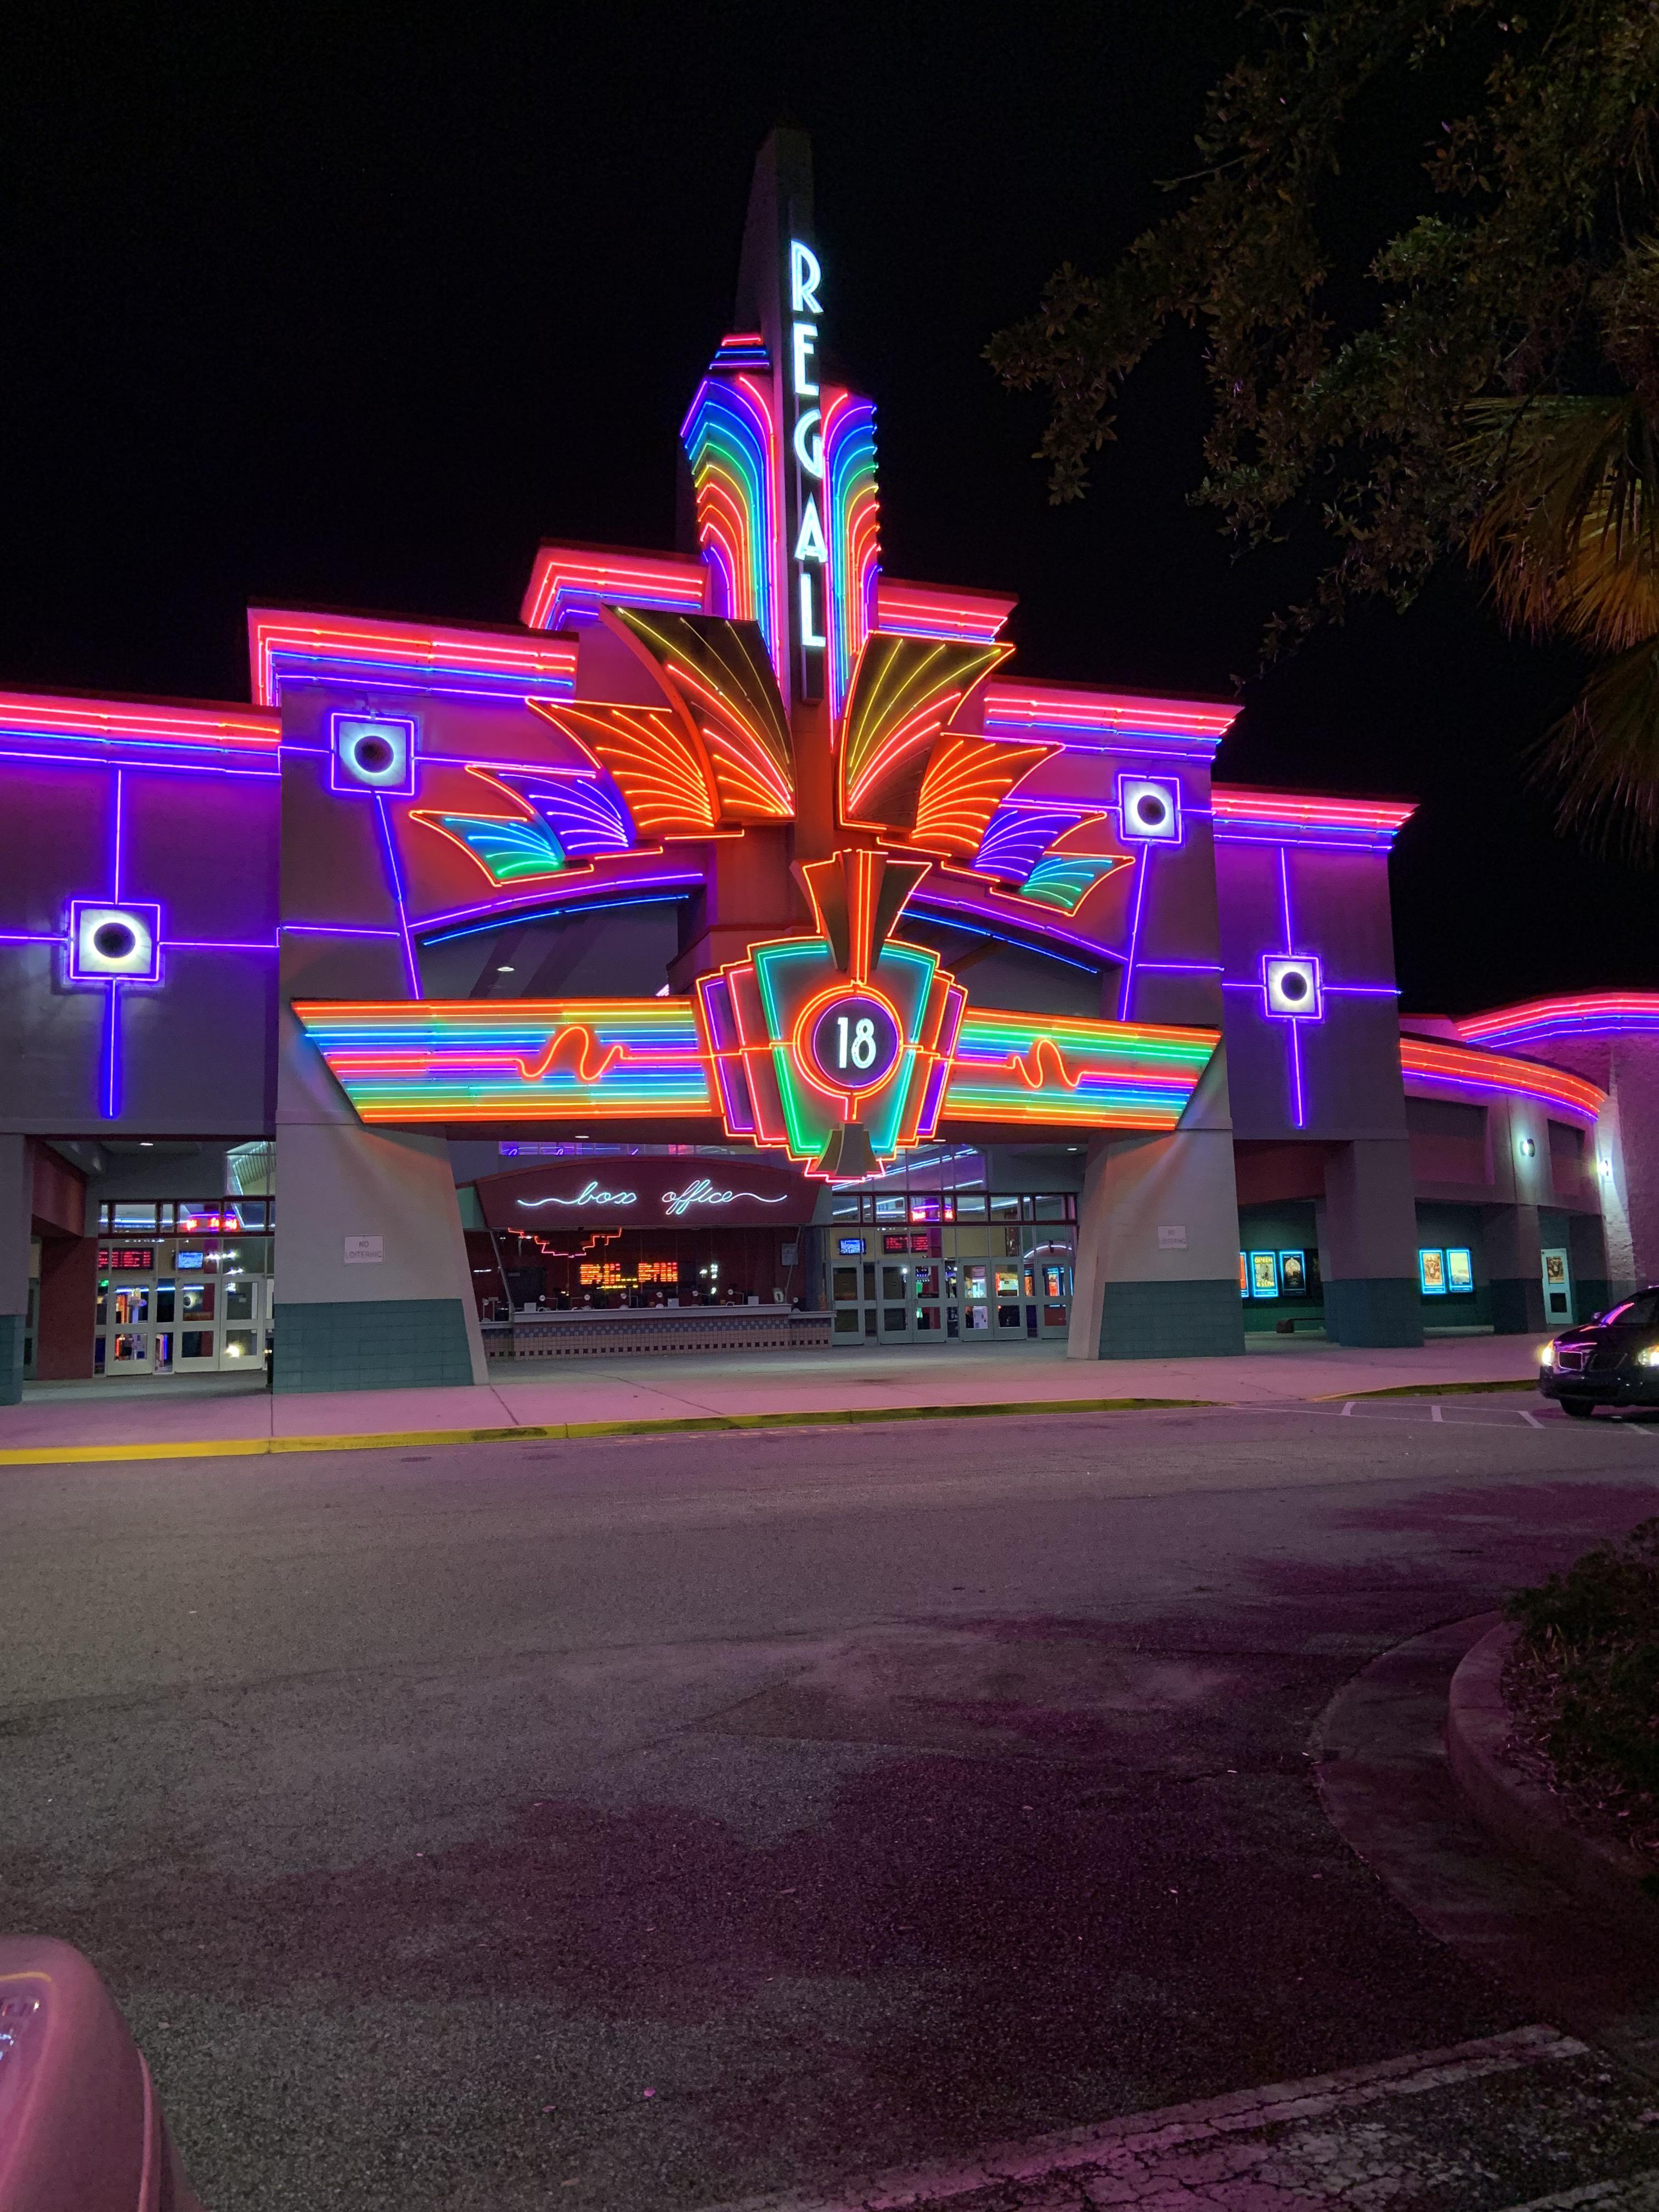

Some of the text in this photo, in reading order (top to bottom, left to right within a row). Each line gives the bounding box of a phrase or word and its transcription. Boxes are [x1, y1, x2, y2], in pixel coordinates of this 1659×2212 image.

[791, 240, 828, 647] REGAL
[838, 1017, 876, 1069] 18
[662, 1179, 788, 1215] office
